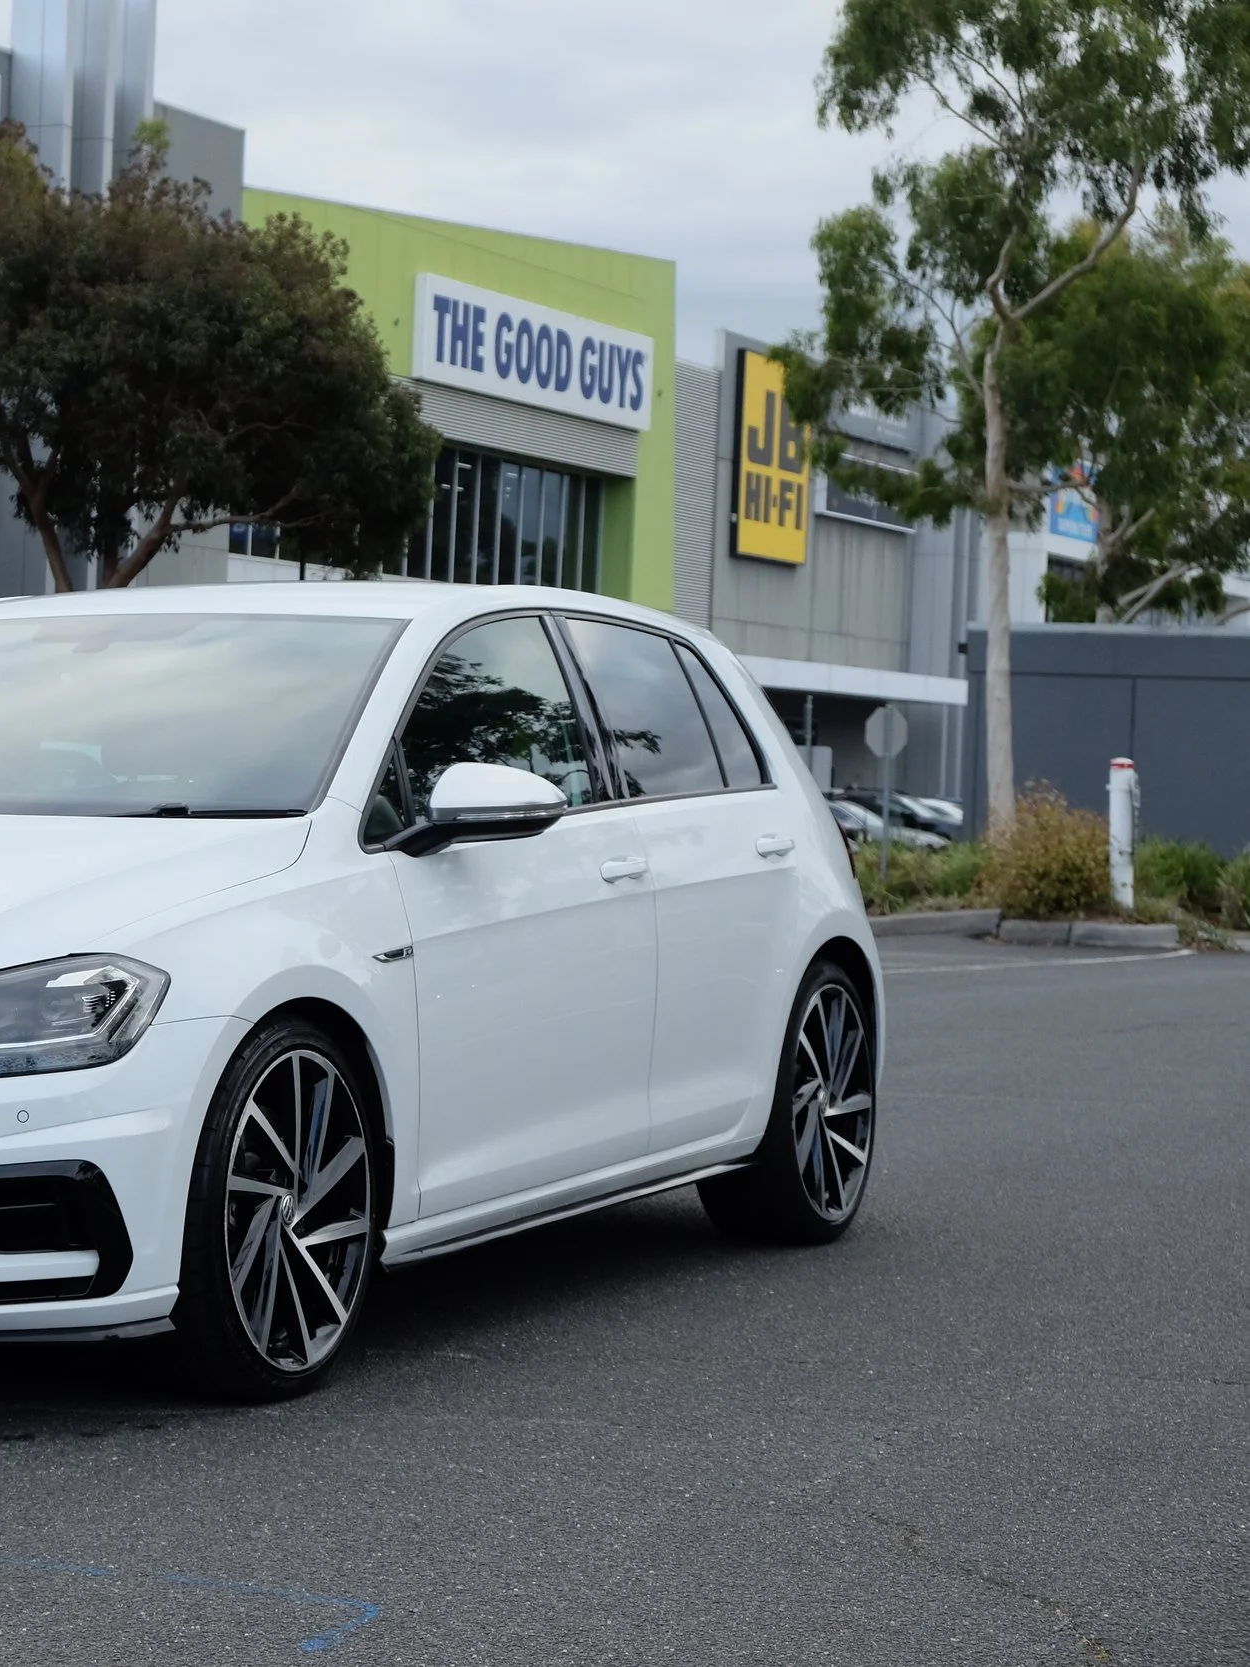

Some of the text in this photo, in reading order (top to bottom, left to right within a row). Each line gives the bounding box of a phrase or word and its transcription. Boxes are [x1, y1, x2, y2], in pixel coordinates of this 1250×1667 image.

[433, 294, 646, 411] THE GOOD GUYS
